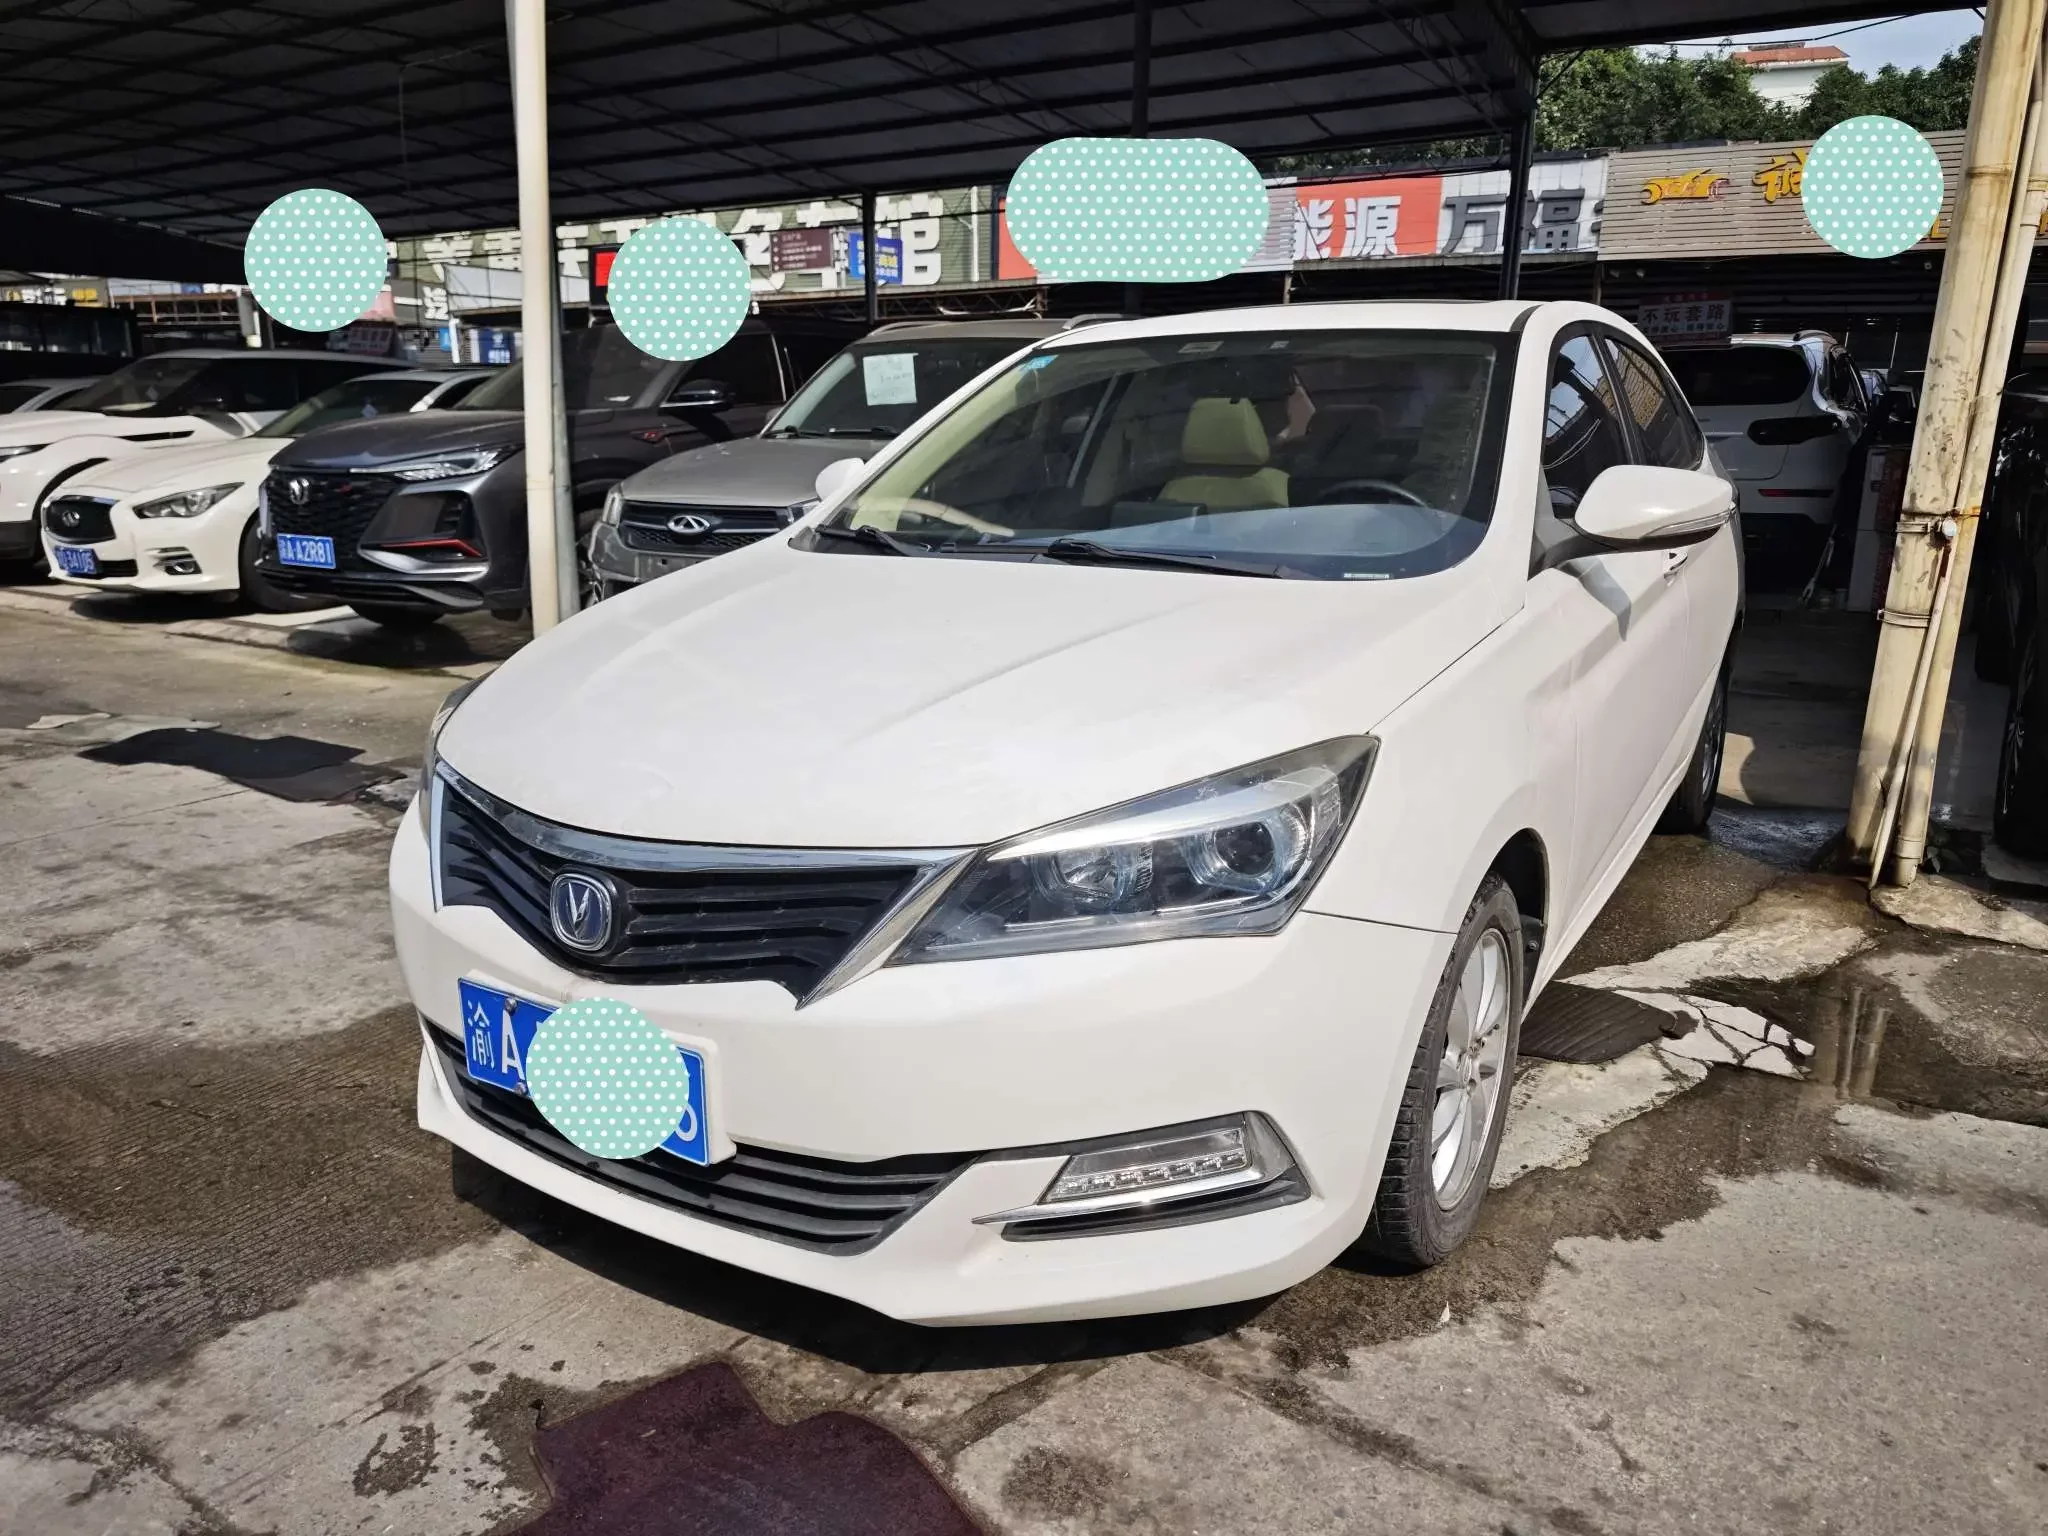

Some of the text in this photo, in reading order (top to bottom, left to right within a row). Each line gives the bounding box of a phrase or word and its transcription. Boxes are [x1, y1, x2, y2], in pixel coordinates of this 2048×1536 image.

[1442, 189, 1603, 252] 万福
[1642, 303, 1725, 324] 不玩套路
